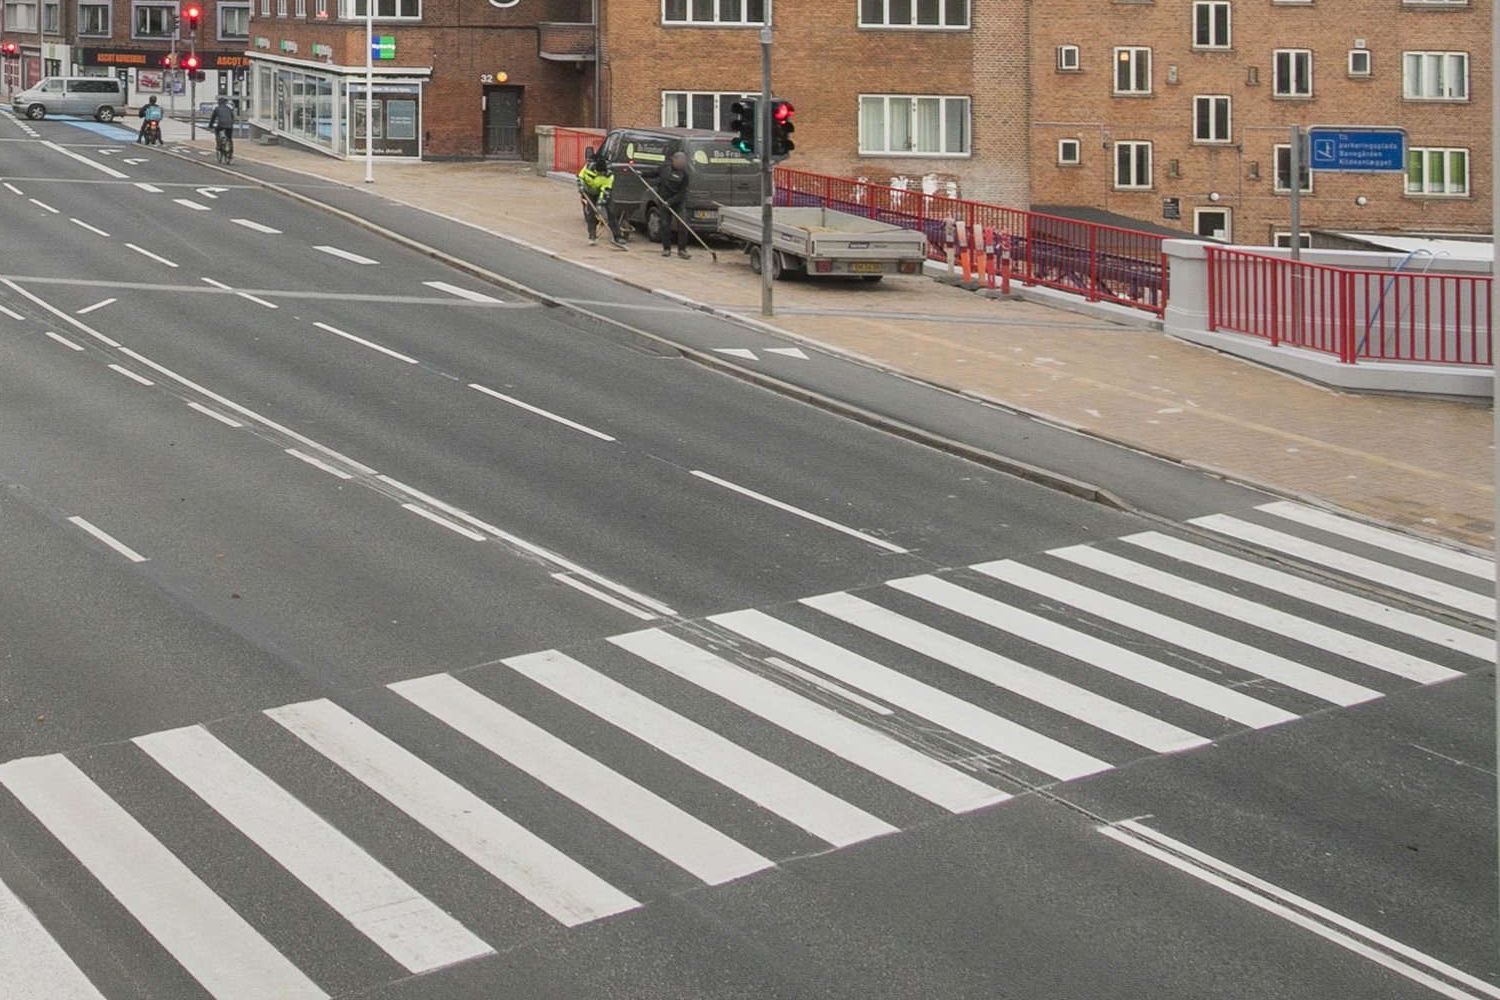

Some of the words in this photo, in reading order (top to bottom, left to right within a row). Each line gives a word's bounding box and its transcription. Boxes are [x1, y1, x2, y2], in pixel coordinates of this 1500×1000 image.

[97, 53, 115, 62] ASCOT
[217, 56, 241, 66] ASCOT
[480, 74, 493, 83] 32
[714, 150, 724, 158] Bo
